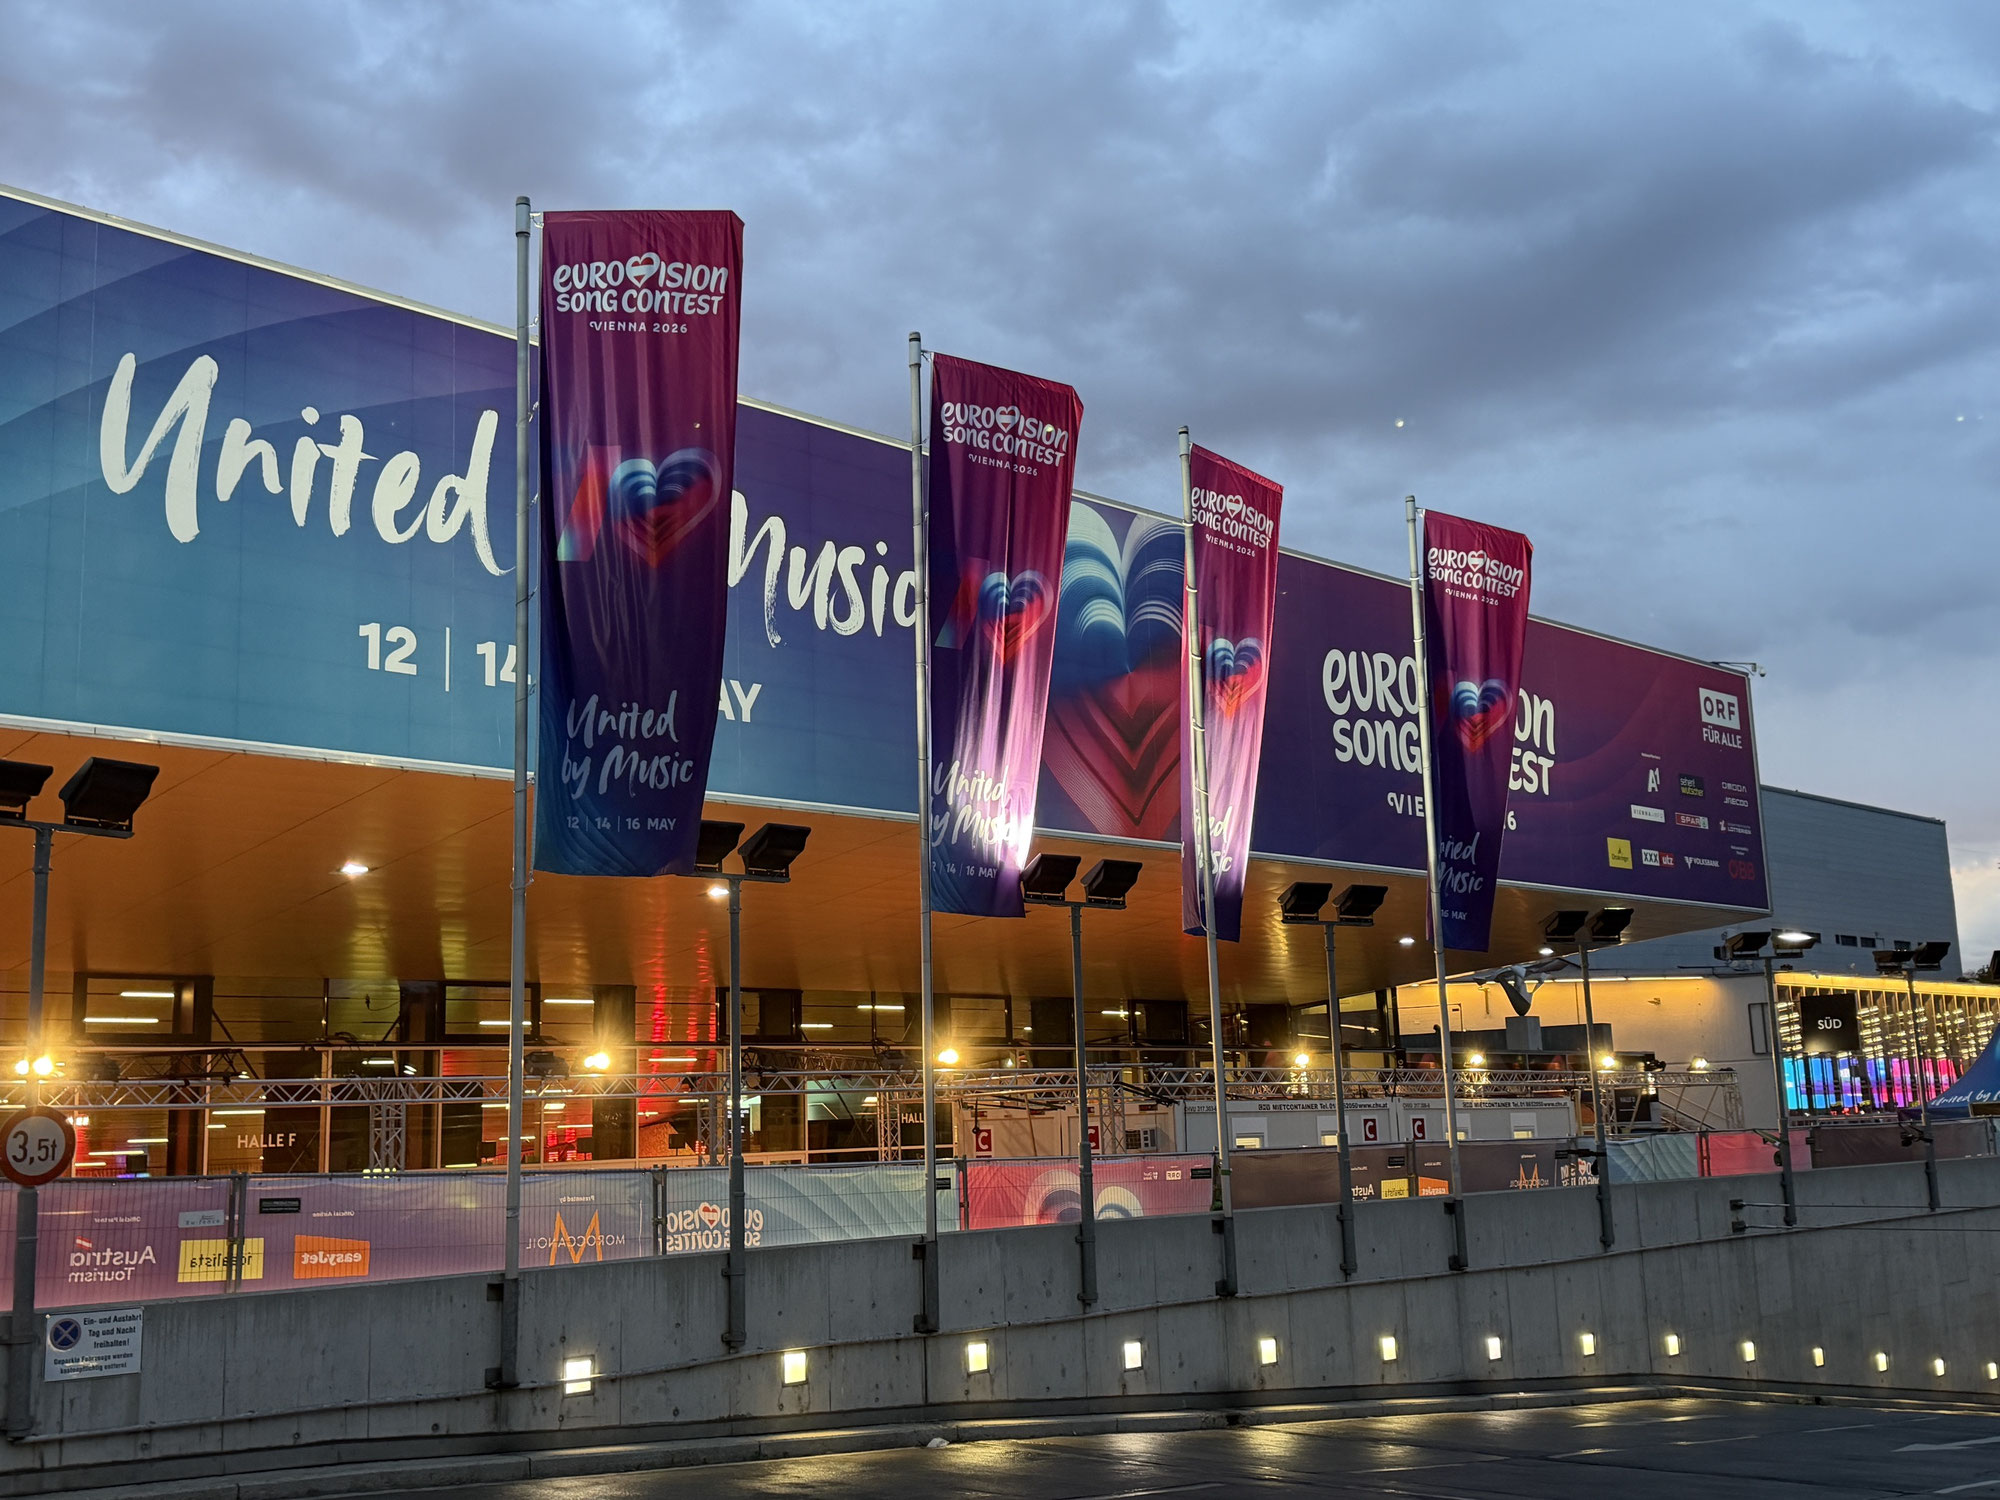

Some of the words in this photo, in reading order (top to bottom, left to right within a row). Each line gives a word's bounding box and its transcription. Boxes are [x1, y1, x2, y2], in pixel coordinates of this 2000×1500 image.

[556, 289, 617, 313] SONG
[621, 288, 723, 315] CONTEST
[589, 321, 647, 331] VIENNA
[652, 322, 687, 333] 2026
[943, 426, 990, 450] SONG
[992, 432, 1065, 467] CONTEST
[101, 353, 515, 576] United
[968, 453, 1010, 469] VIENNA
[1012, 463, 1038, 476] 2026
[1191, 508, 1221, 532] SONG
[1428, 567, 1462, 585] SONG
[1463, 572, 1520, 598] CONTEST
[358, 622, 418, 676] 12
[566, 690, 679, 749] United
[1703, 696, 1736, 721] ORF
[1702, 725, 1721, 745] FÜR
[1721, 731, 1743, 749] ALLE
[561, 739, 592, 800] by
[598, 745, 694, 798] Music
[1647, 767, 1660, 792] A1
[933, 760, 1009, 806] United
[567, 816, 580, 829] 12
[595, 817, 611, 830] 14
[626, 818, 641, 830] 16
[647, 818, 677, 831] MAY
[1817, 1017, 1842, 1030] SÜD
[238, 1134, 285, 1149] HALLE
[288, 1132, 297, 1147] F
[978, 1131, 989, 1150] C
[1366, 1121, 1374, 1139] C
[1415, 1120, 1423, 1138] C
[11, 1130, 57, 1166] 3,5t
[83, 1318, 97, 1326] Ein-
[98, 1316, 111, 1324] und
[112, 1313, 142, 1323] Ausfahrt
[88, 1329, 100, 1338] Tag
[115, 1326, 136, 1334] Nacht
